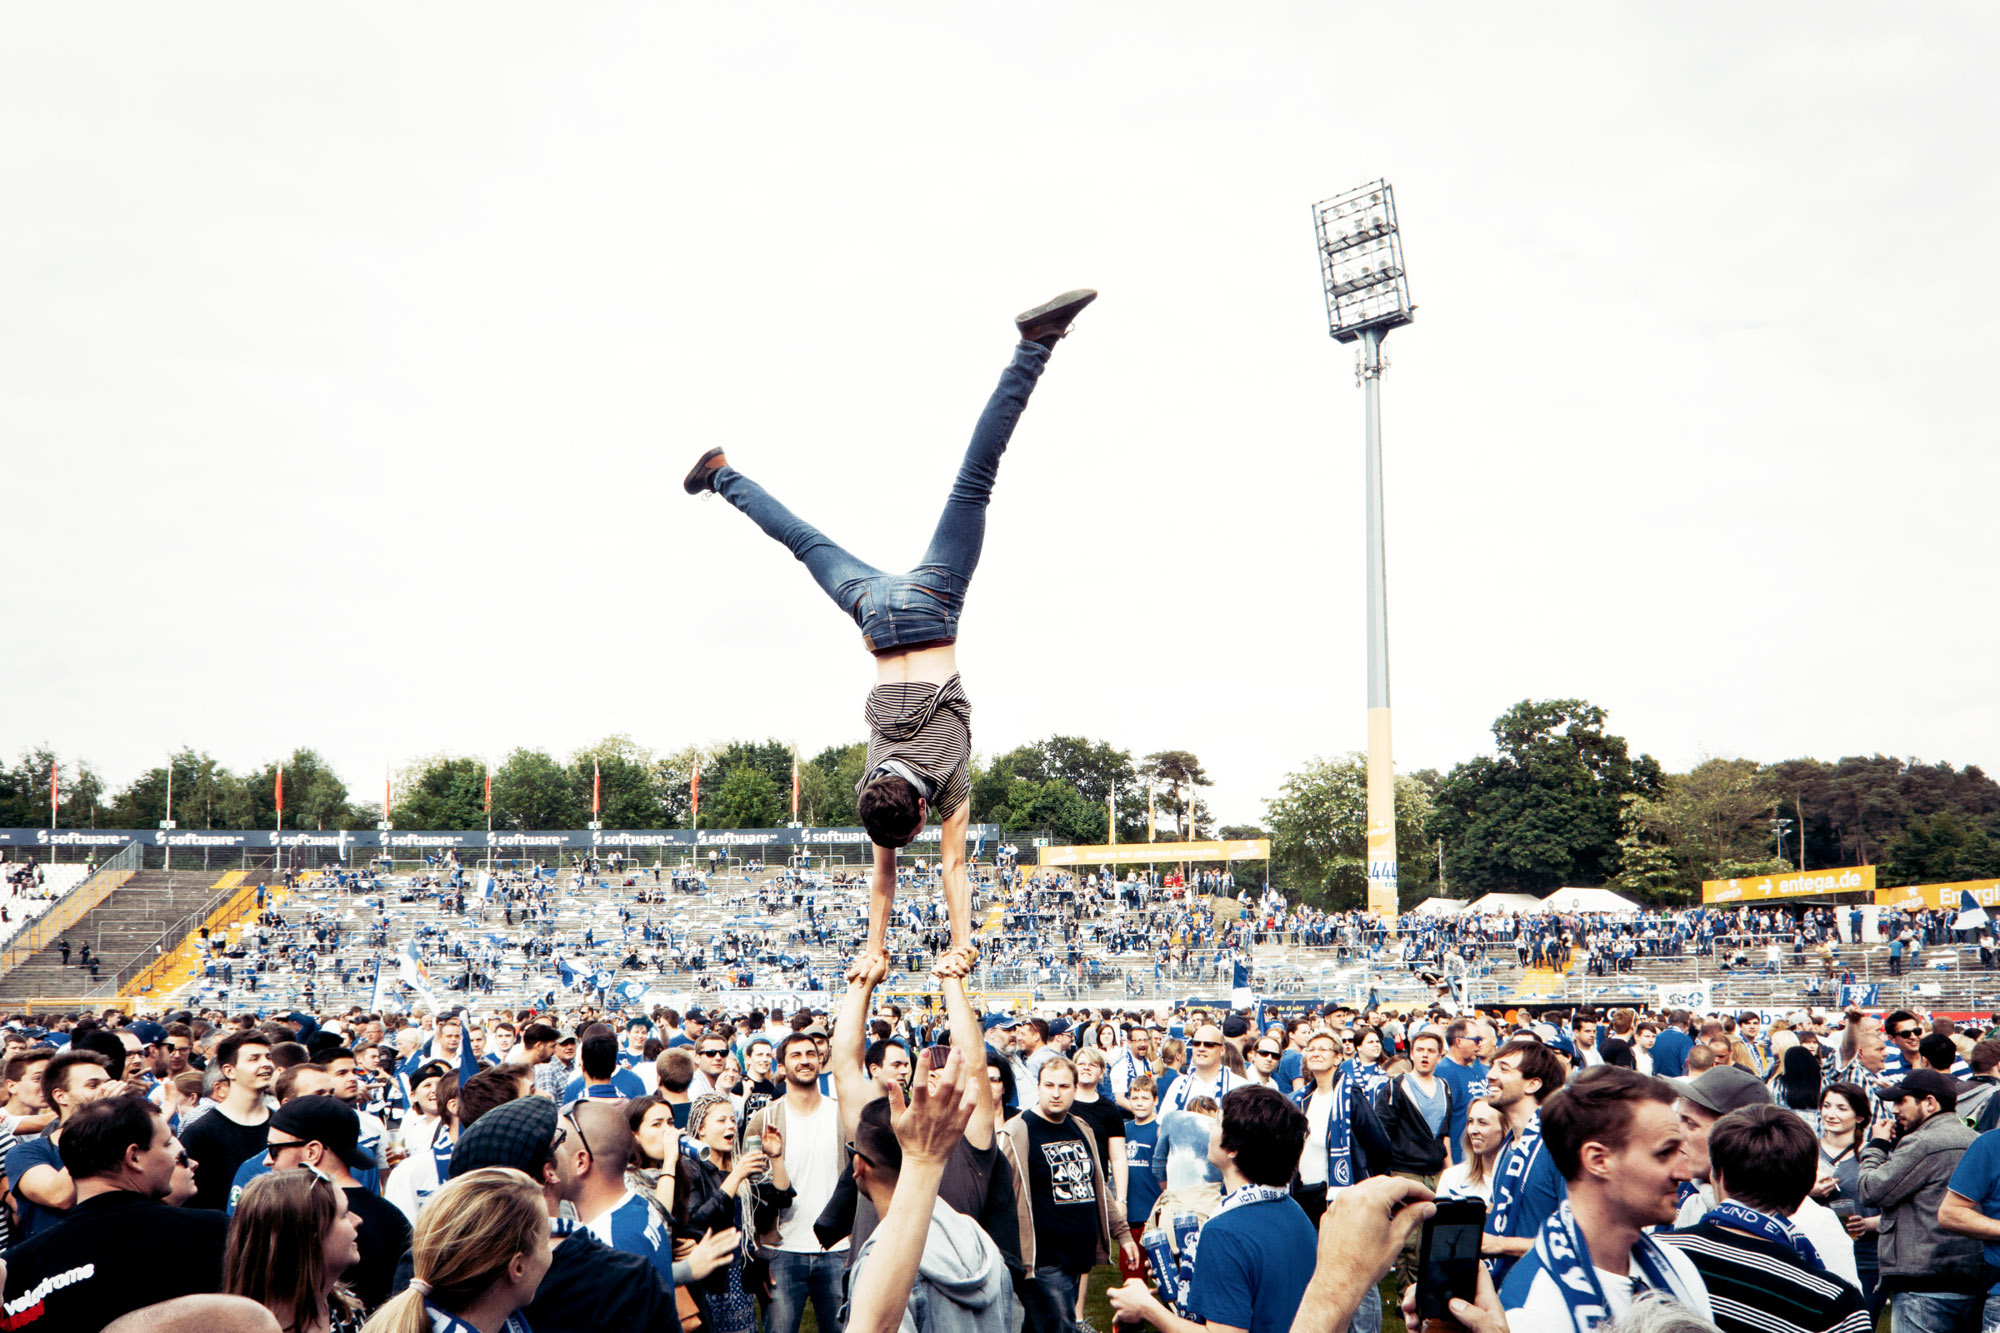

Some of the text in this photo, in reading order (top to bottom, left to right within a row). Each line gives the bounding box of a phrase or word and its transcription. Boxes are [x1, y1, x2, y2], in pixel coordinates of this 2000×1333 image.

[50, 831, 120, 845] software
[168, 832, 235, 845] software
[391, 833, 455, 846] software
[498, 833, 561, 845] software
[604, 832, 665, 845] software
[709, 830, 769, 844] software
[916, 828, 978, 841] softre
[1779, 870, 1862, 894] entega.de
[1715, 886, 1743, 902] entega
[1239, 1191, 1257, 1203] ich
[1258, 1188, 1278, 1200] lass
[3, 1263, 95, 1316] velodrome
